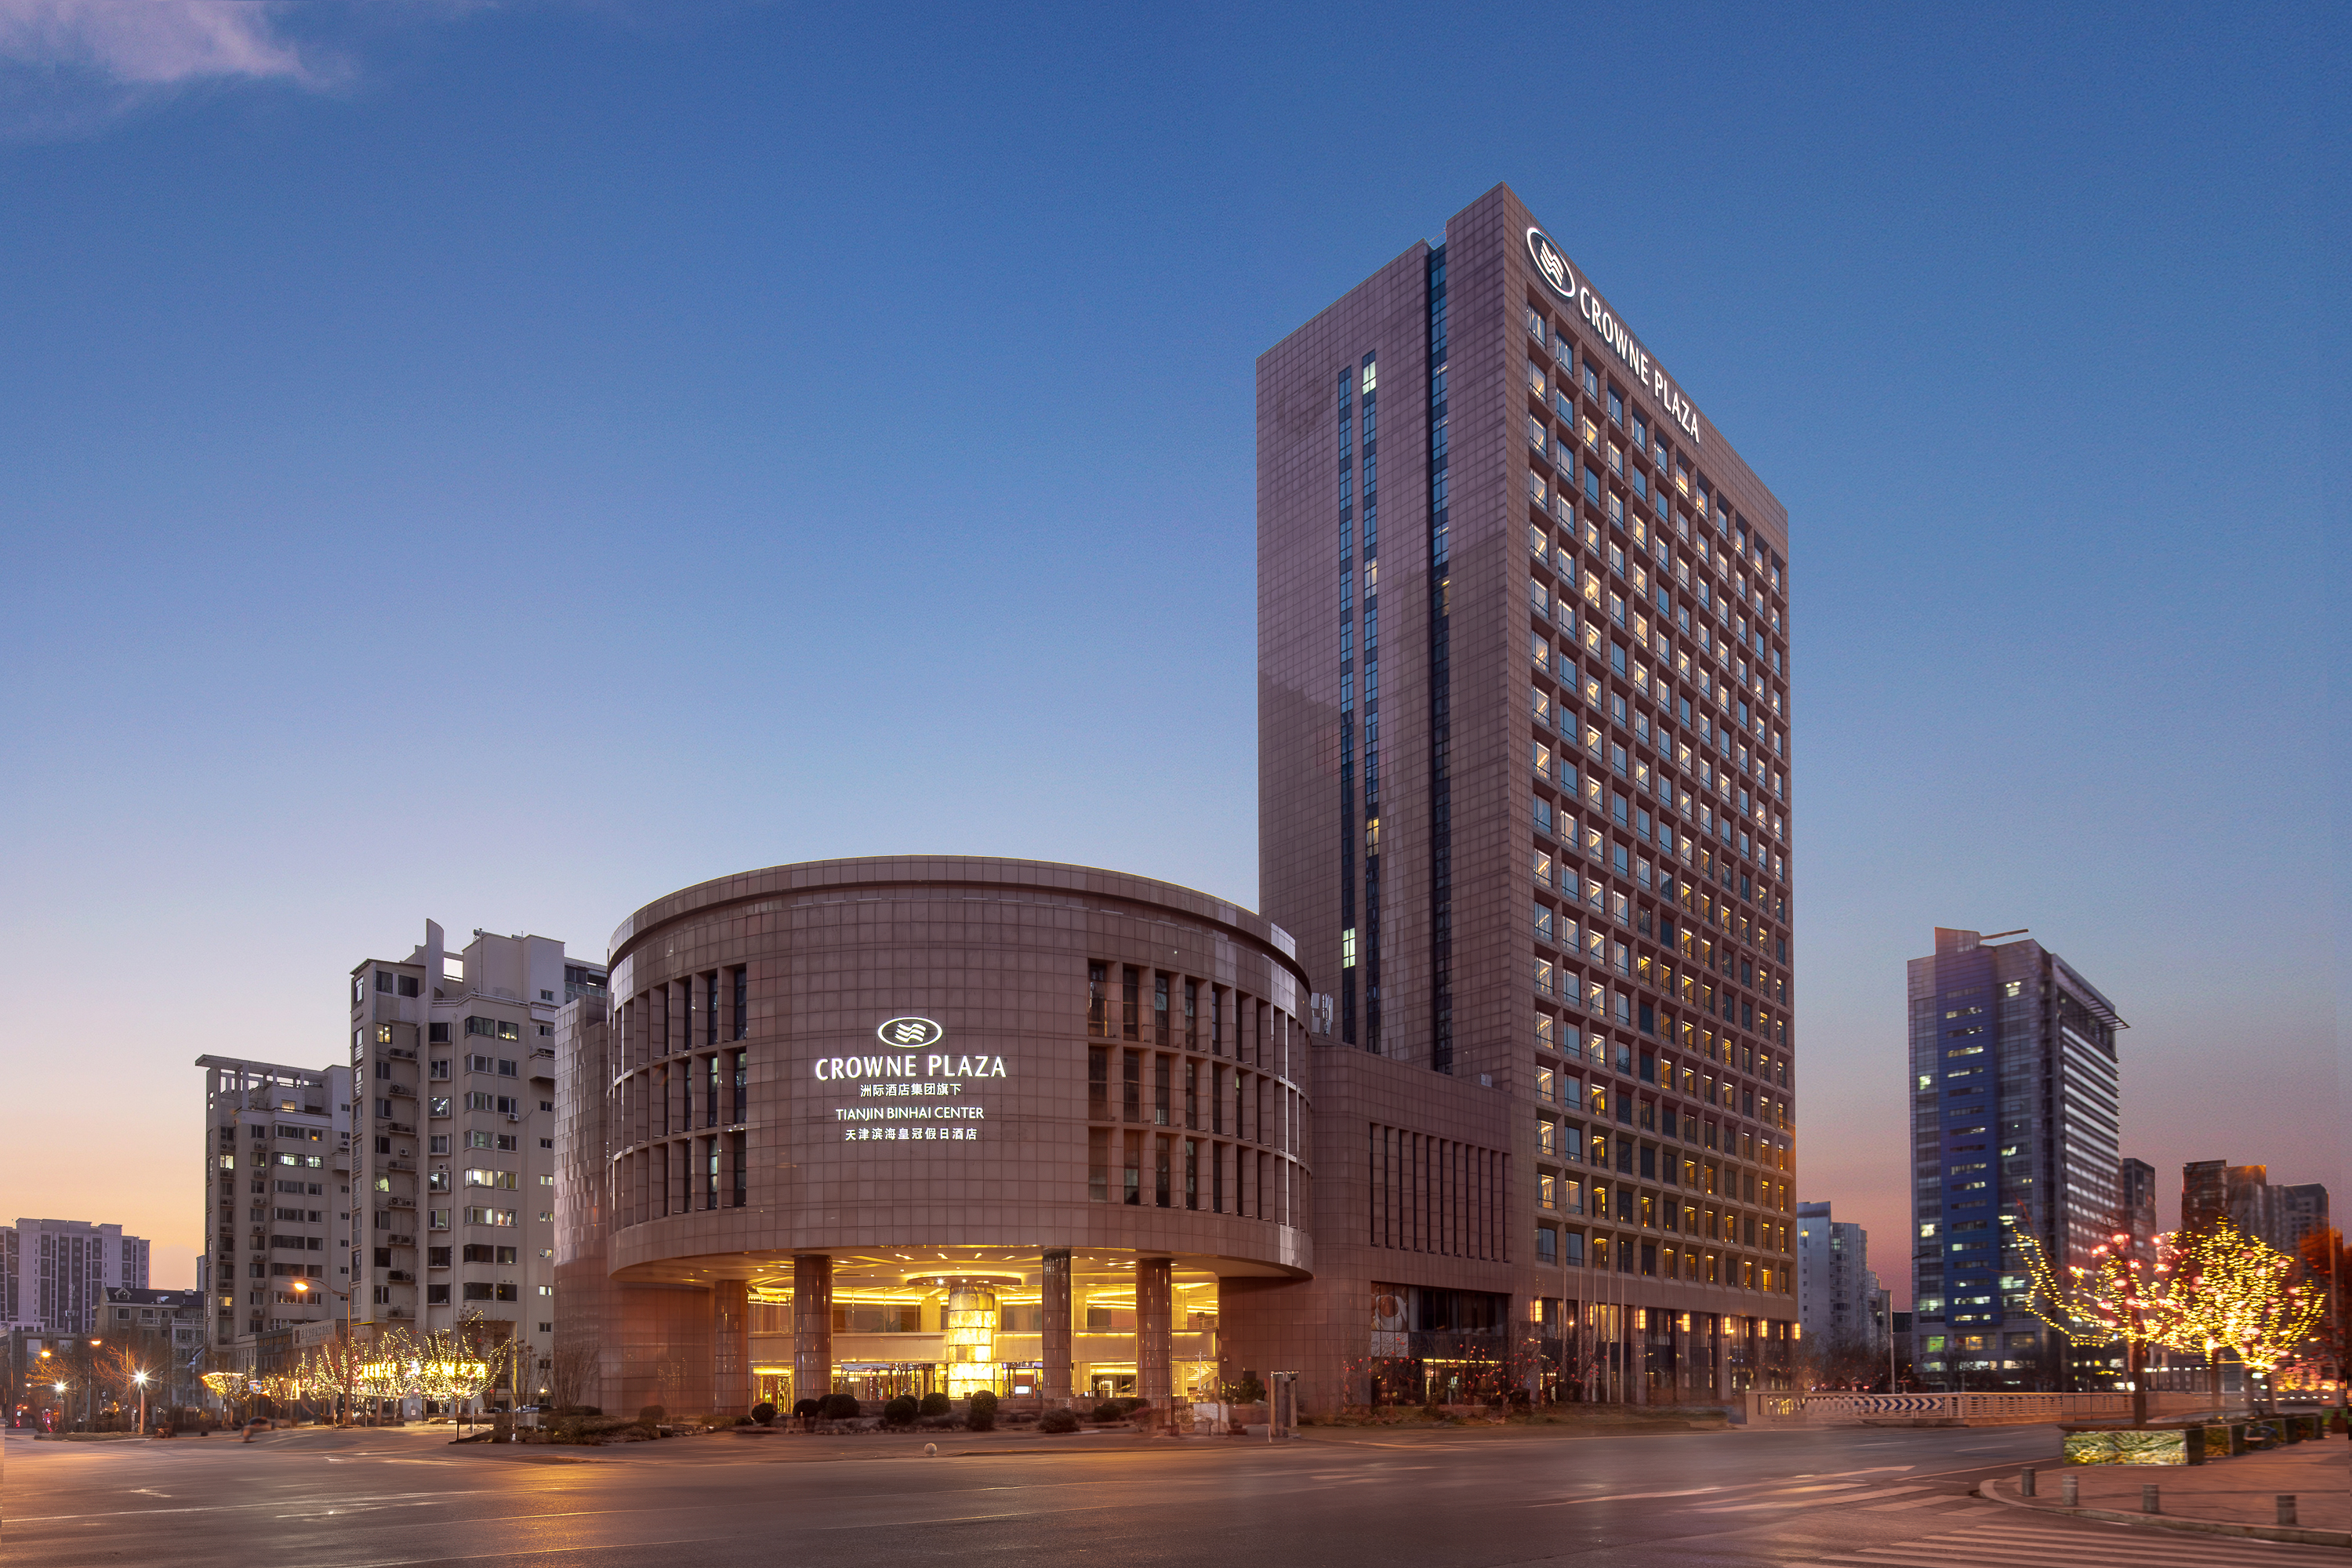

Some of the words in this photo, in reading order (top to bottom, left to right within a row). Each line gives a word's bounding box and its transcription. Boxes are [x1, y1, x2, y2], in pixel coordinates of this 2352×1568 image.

[1580, 287, 1649, 386] CROWNE
[1654, 369, 1700, 444] PLAZA
[815, 1055, 916, 1080] CROWNE
[928, 1054, 1007, 1078] PLAZA
[860, 1083, 962, 1098] 洲际酒店集团旗下
[836, 1107, 884, 1121] TIANJIN
[887, 1106, 931, 1119] BINHAI
[935, 1106, 985, 1120] CENTER
[845, 1127, 978, 1141] 天津滨海皇冠假日酒店
